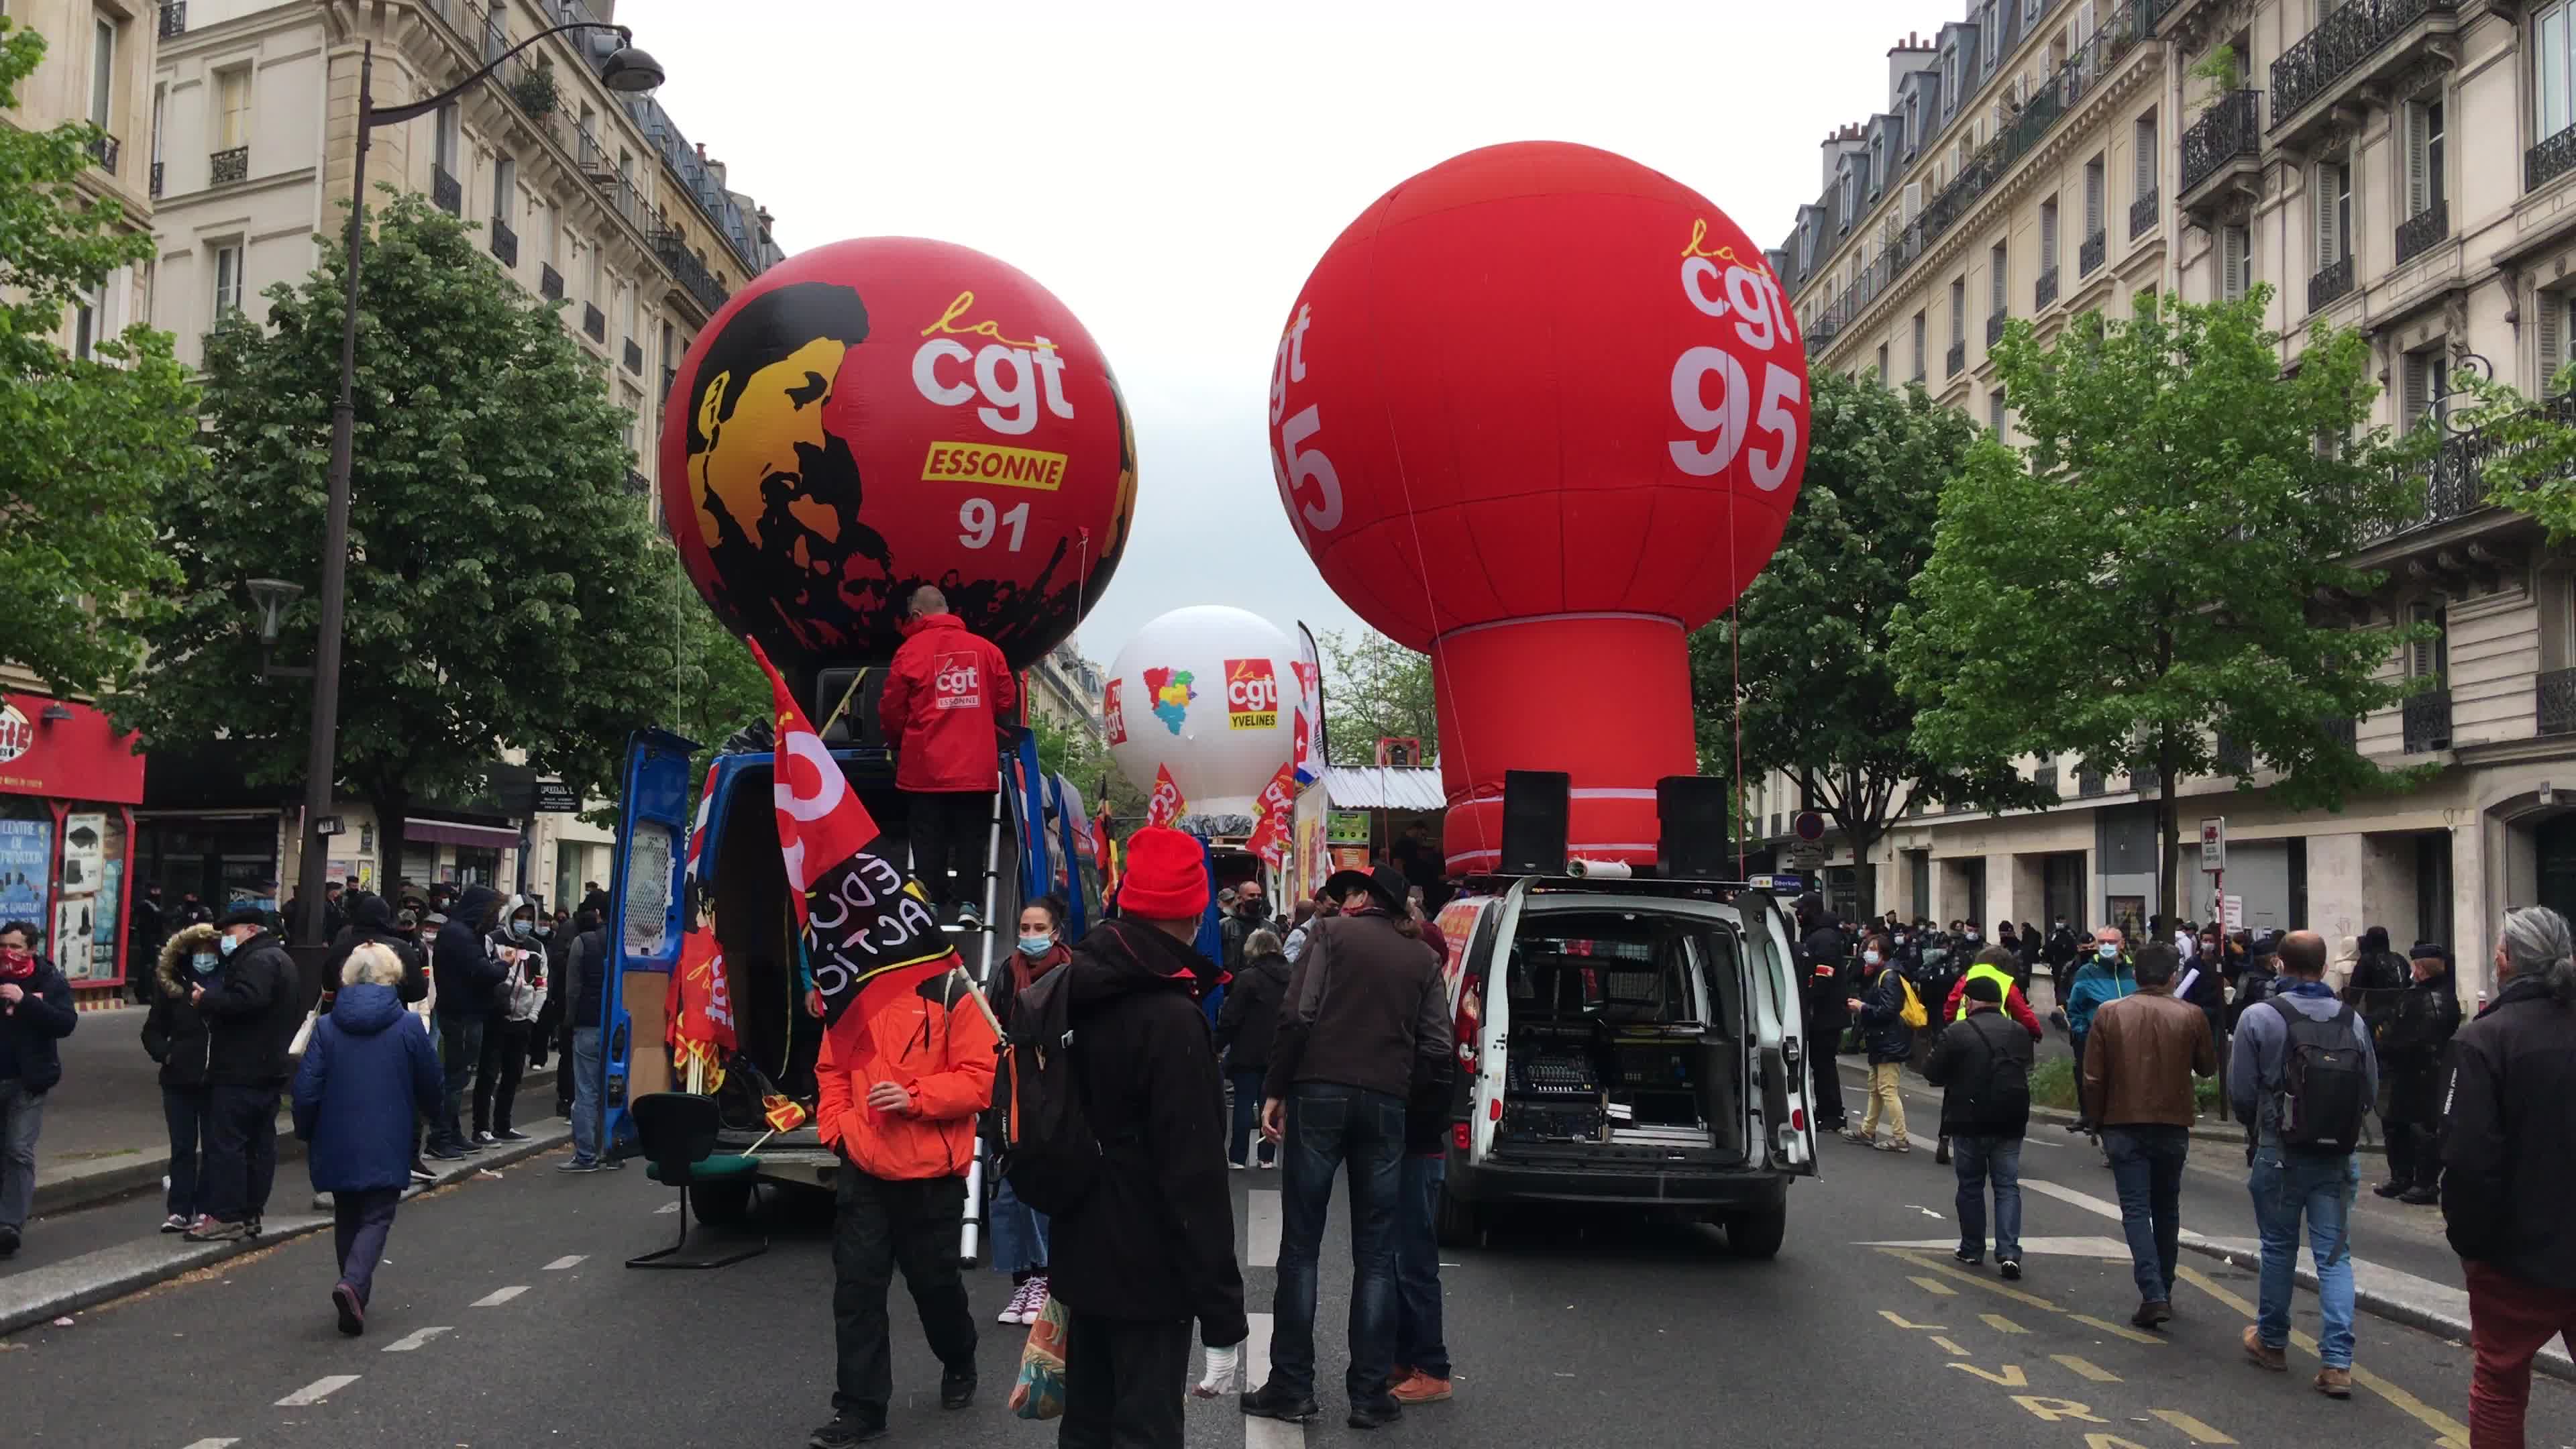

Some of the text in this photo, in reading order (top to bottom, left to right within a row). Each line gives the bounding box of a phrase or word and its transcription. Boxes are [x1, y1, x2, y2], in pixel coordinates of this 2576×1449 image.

[921, 290, 1059, 349] la
[1681, 256, 1793, 351] cgt
[912, 335, 1075, 435] cgt
[1668, 345, 1801, 492] 95
[928, 448, 1063, 485] ESSONNE
[959, 497, 1030, 553] 91
[936, 666, 977, 694] cgt
[1228, 674, 1277, 710] cgt
[1232, 714, 1275, 727] YVELINES
